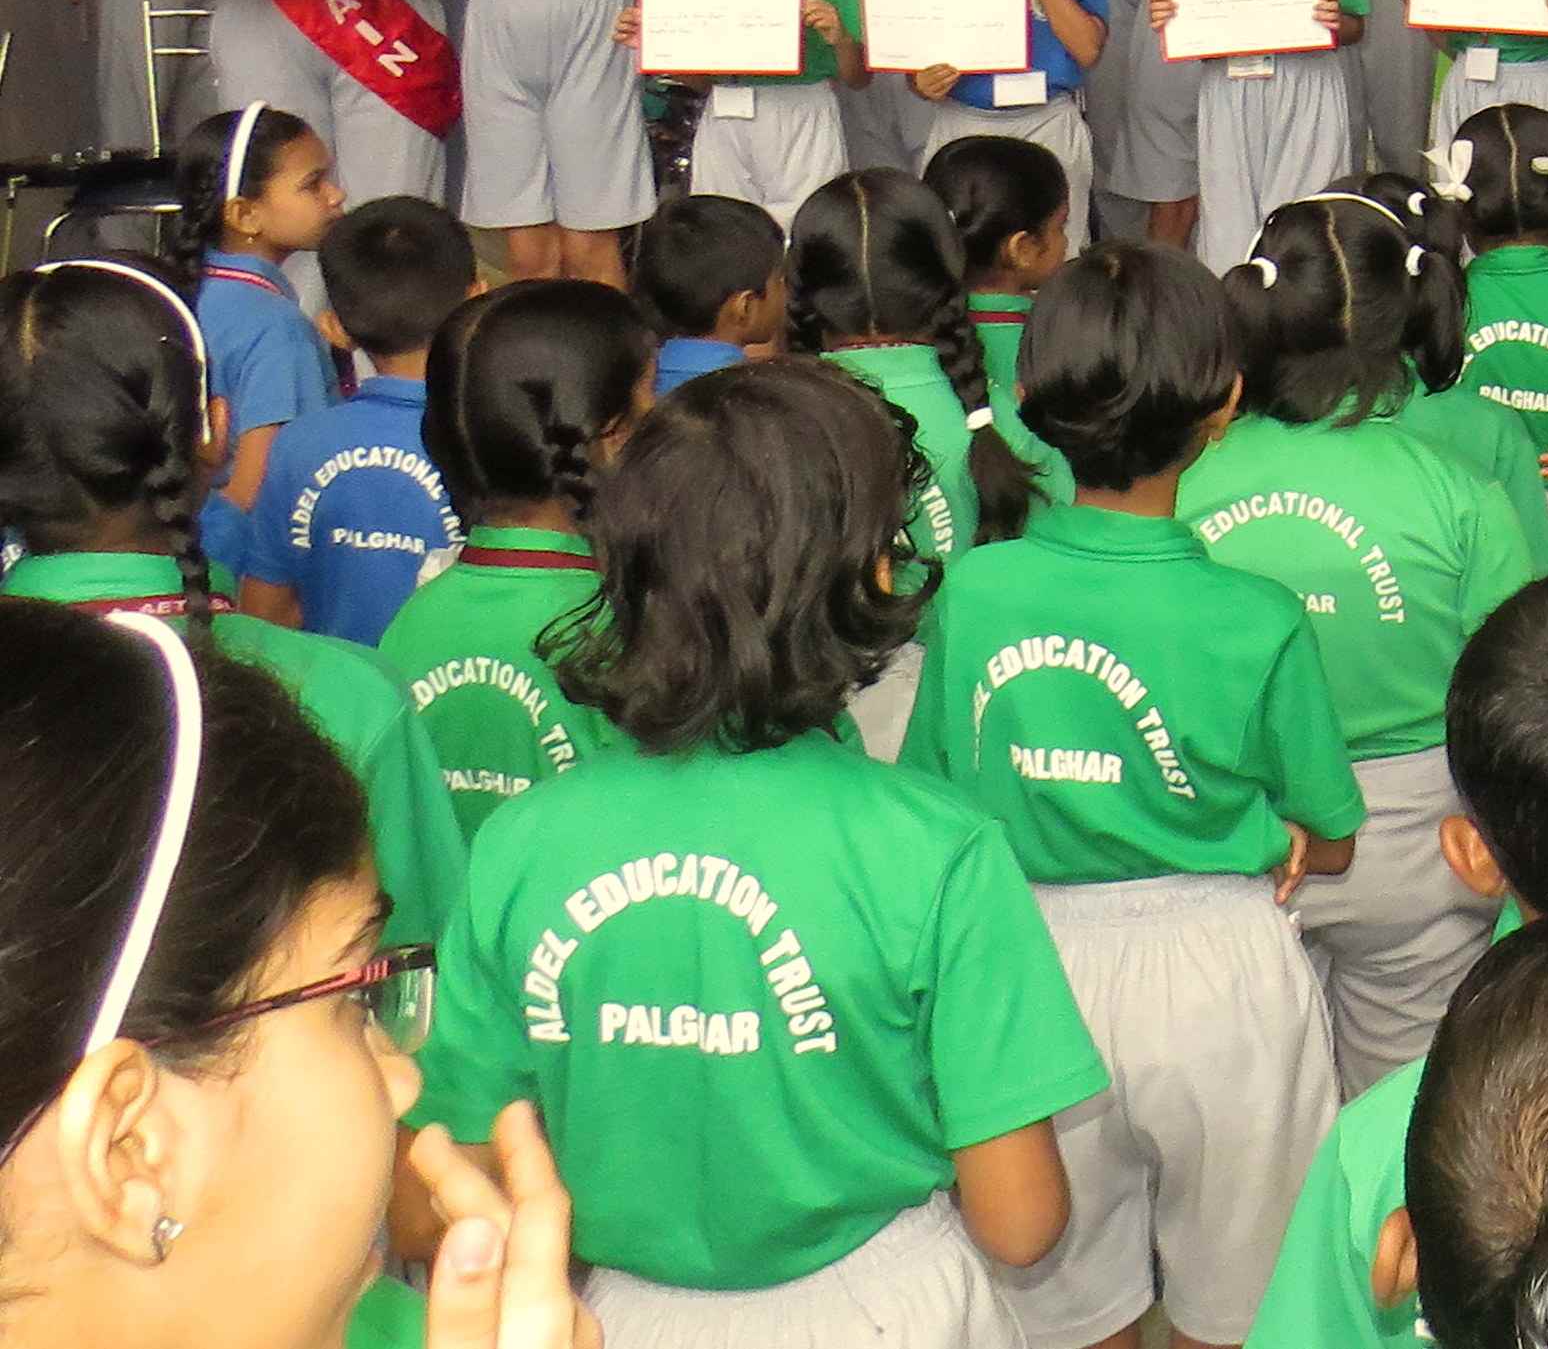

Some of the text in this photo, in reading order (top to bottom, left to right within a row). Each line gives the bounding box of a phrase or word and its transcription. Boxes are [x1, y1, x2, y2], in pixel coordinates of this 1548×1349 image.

[289, 485, 320, 549] ALDEL
[314, 446, 446, 502] EDUCATIONAL
[1198, 490, 1406, 625] EDUCATIONAL TRUST
[410, 655, 551, 726] DUCATIONAL
[986, 634, 1197, 802] EDUCATION TRUST
[1010, 742, 1124, 785] PALGHAR
[523, 851, 838, 1055] ALDEL EDUCATION TRUST
